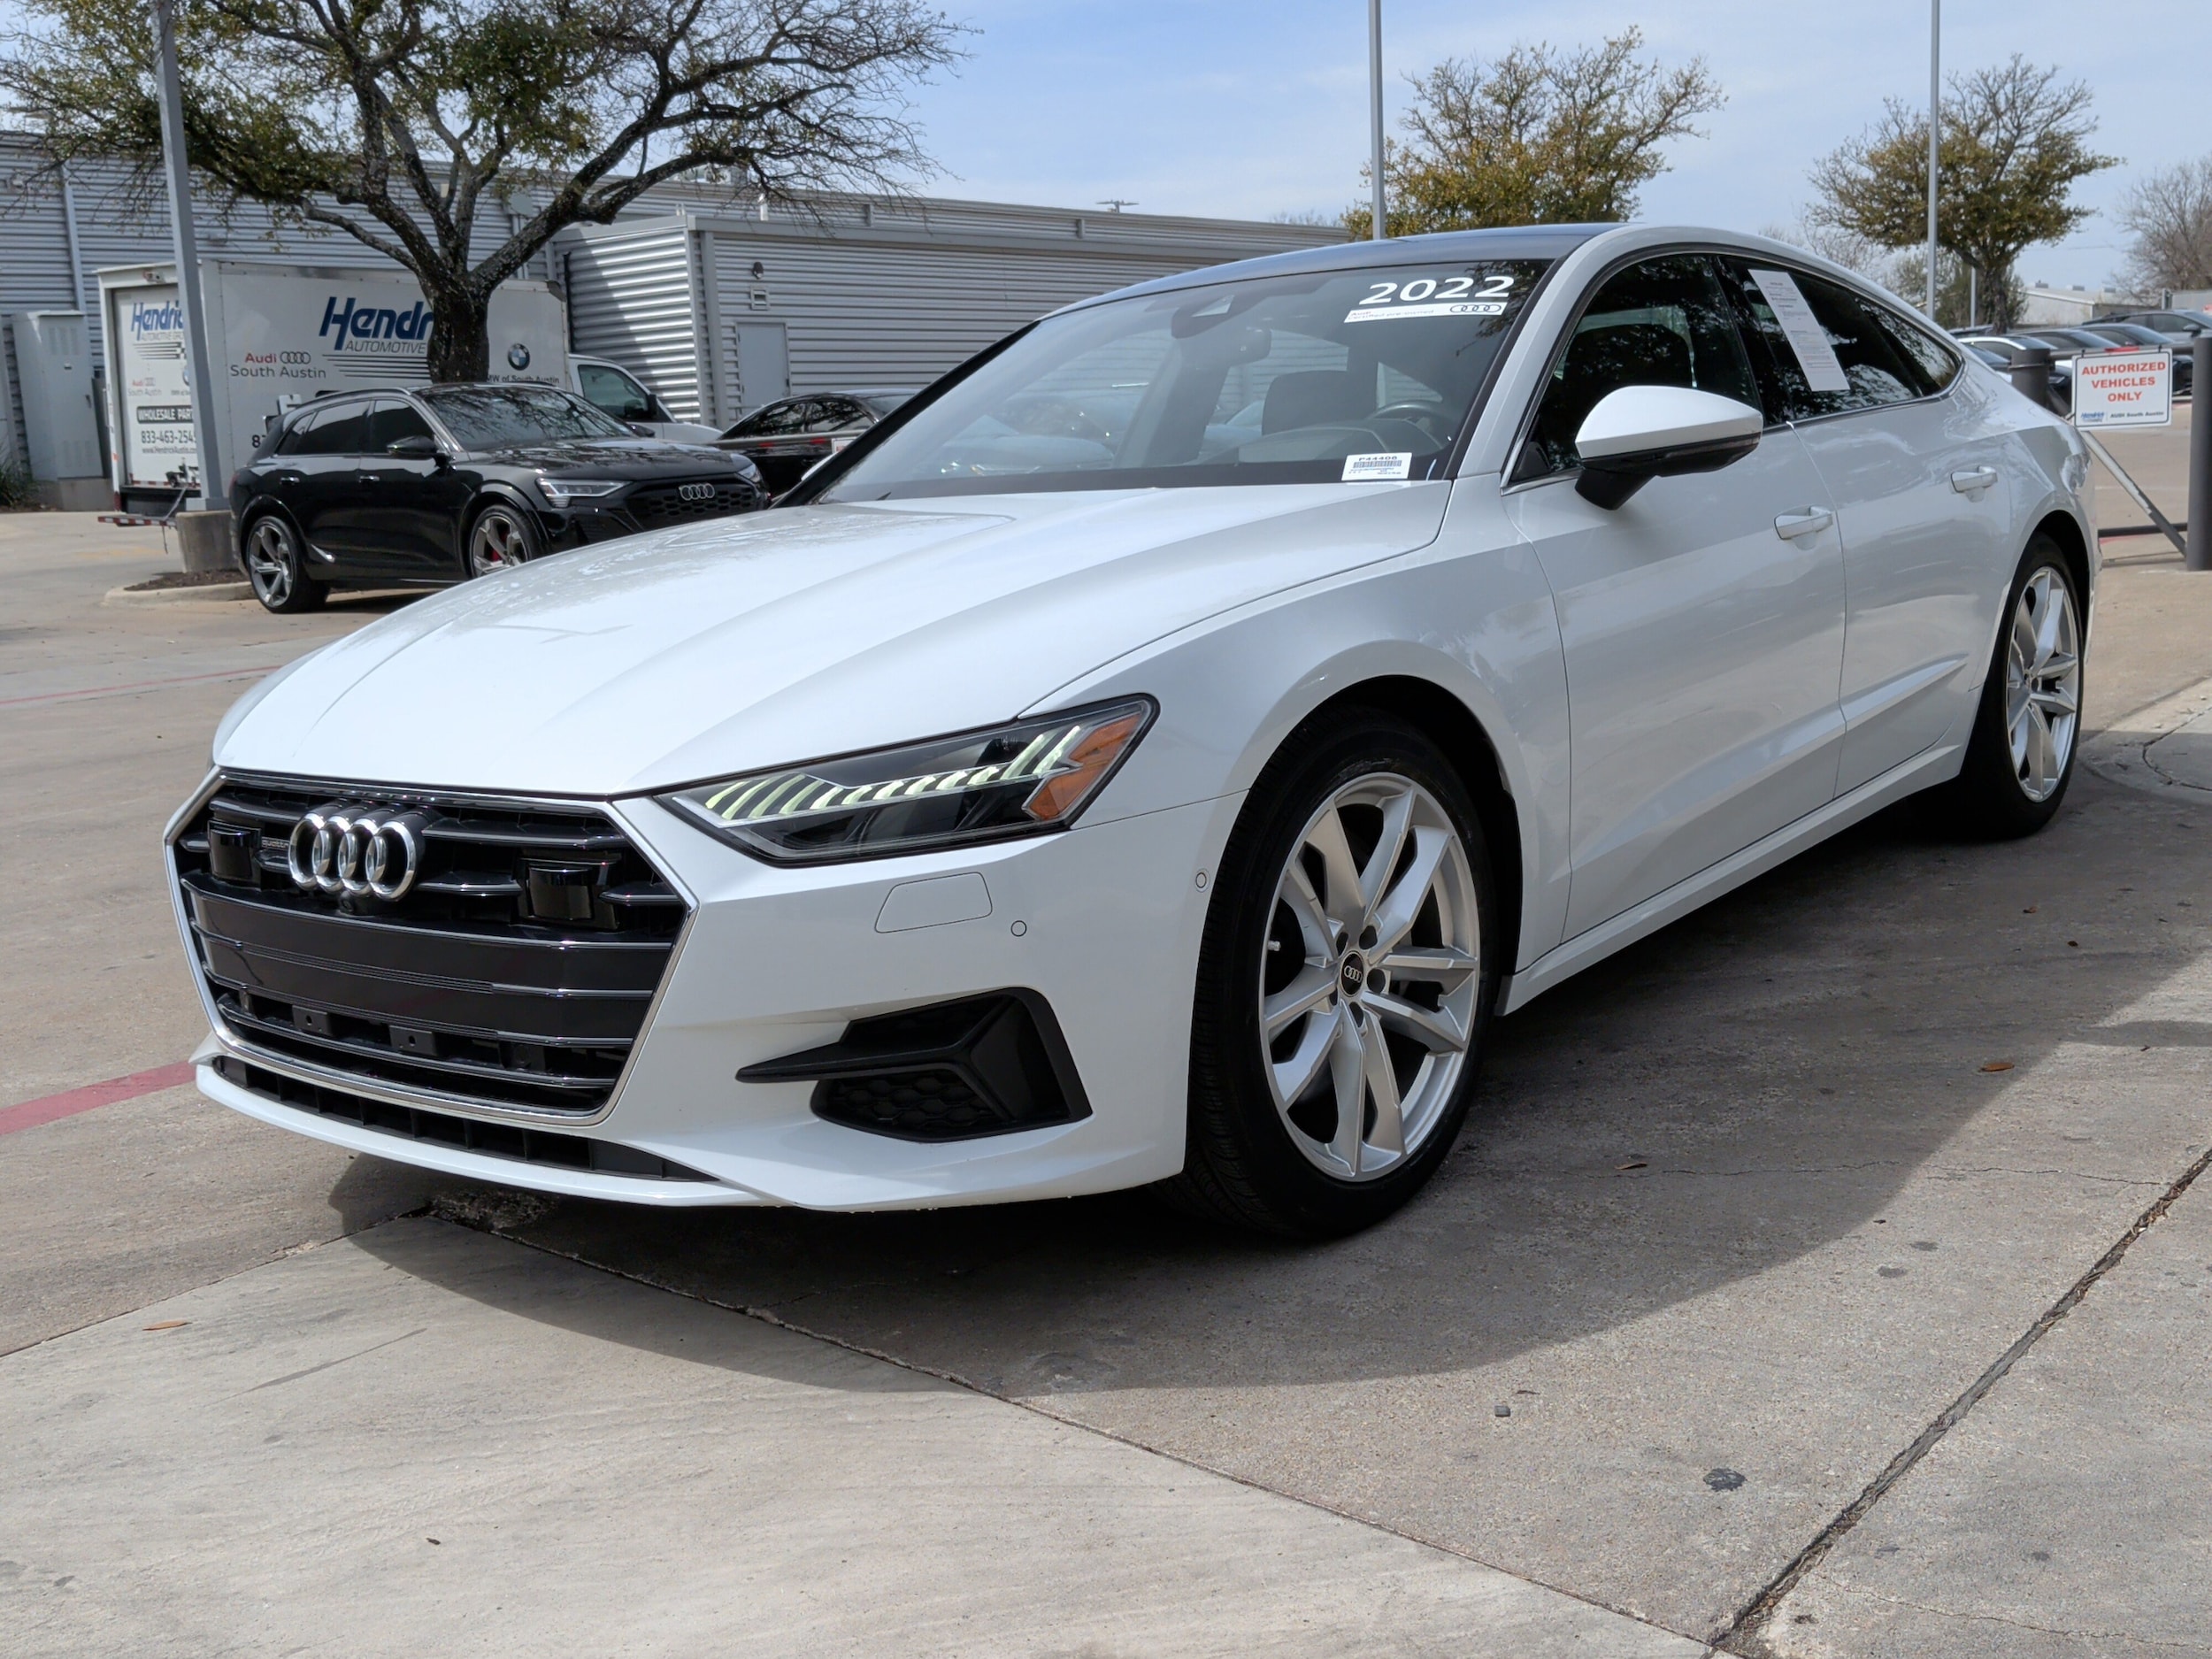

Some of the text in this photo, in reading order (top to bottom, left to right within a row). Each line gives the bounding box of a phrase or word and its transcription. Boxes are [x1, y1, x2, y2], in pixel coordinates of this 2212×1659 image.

[1358, 276, 1514, 305] 2022
[131, 300, 184, 341] Hendric
[319, 296, 434, 350] Hendr
[345, 340, 426, 355] AUTOMOTIVE
[244, 352, 277, 364] Audi
[230, 364, 326, 379] South Austin
[2082, 362, 2166, 375] AUTHORIZED
[2092, 377, 2155, 389] VEHICLES
[2108, 392, 2142, 402] ONLY
[138, 408, 176, 421] WHOLESALE
